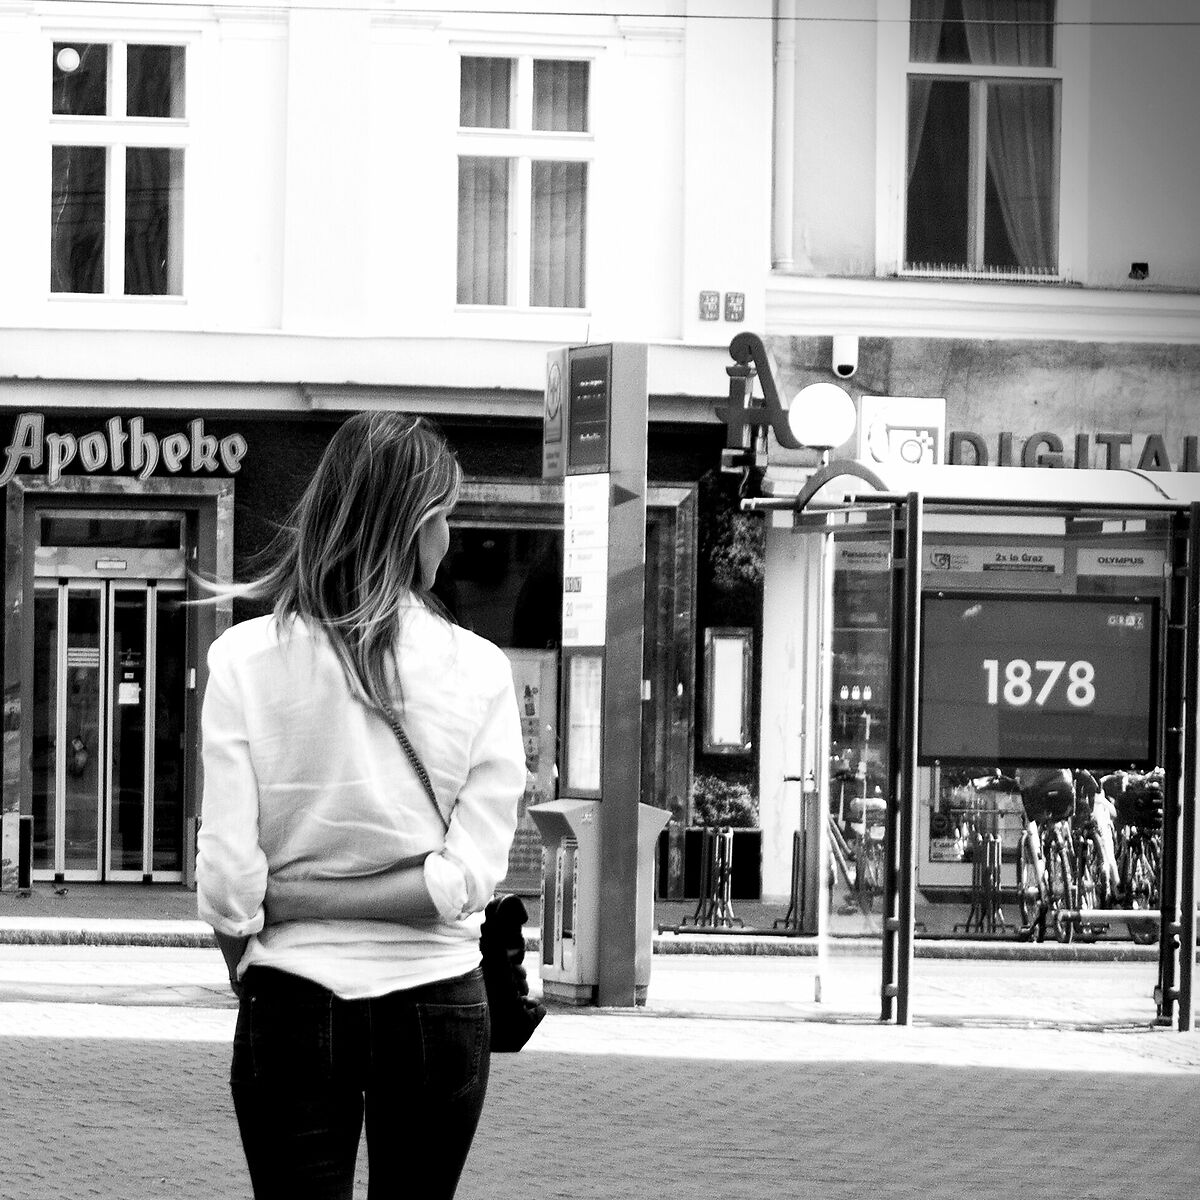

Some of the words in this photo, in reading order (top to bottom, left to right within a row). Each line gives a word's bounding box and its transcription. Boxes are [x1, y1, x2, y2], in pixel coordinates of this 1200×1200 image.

[1021, 552, 1044, 562] Graz
[1097, 556, 1144, 564] OLYMPUS
[983, 659, 1096, 707] 1878
